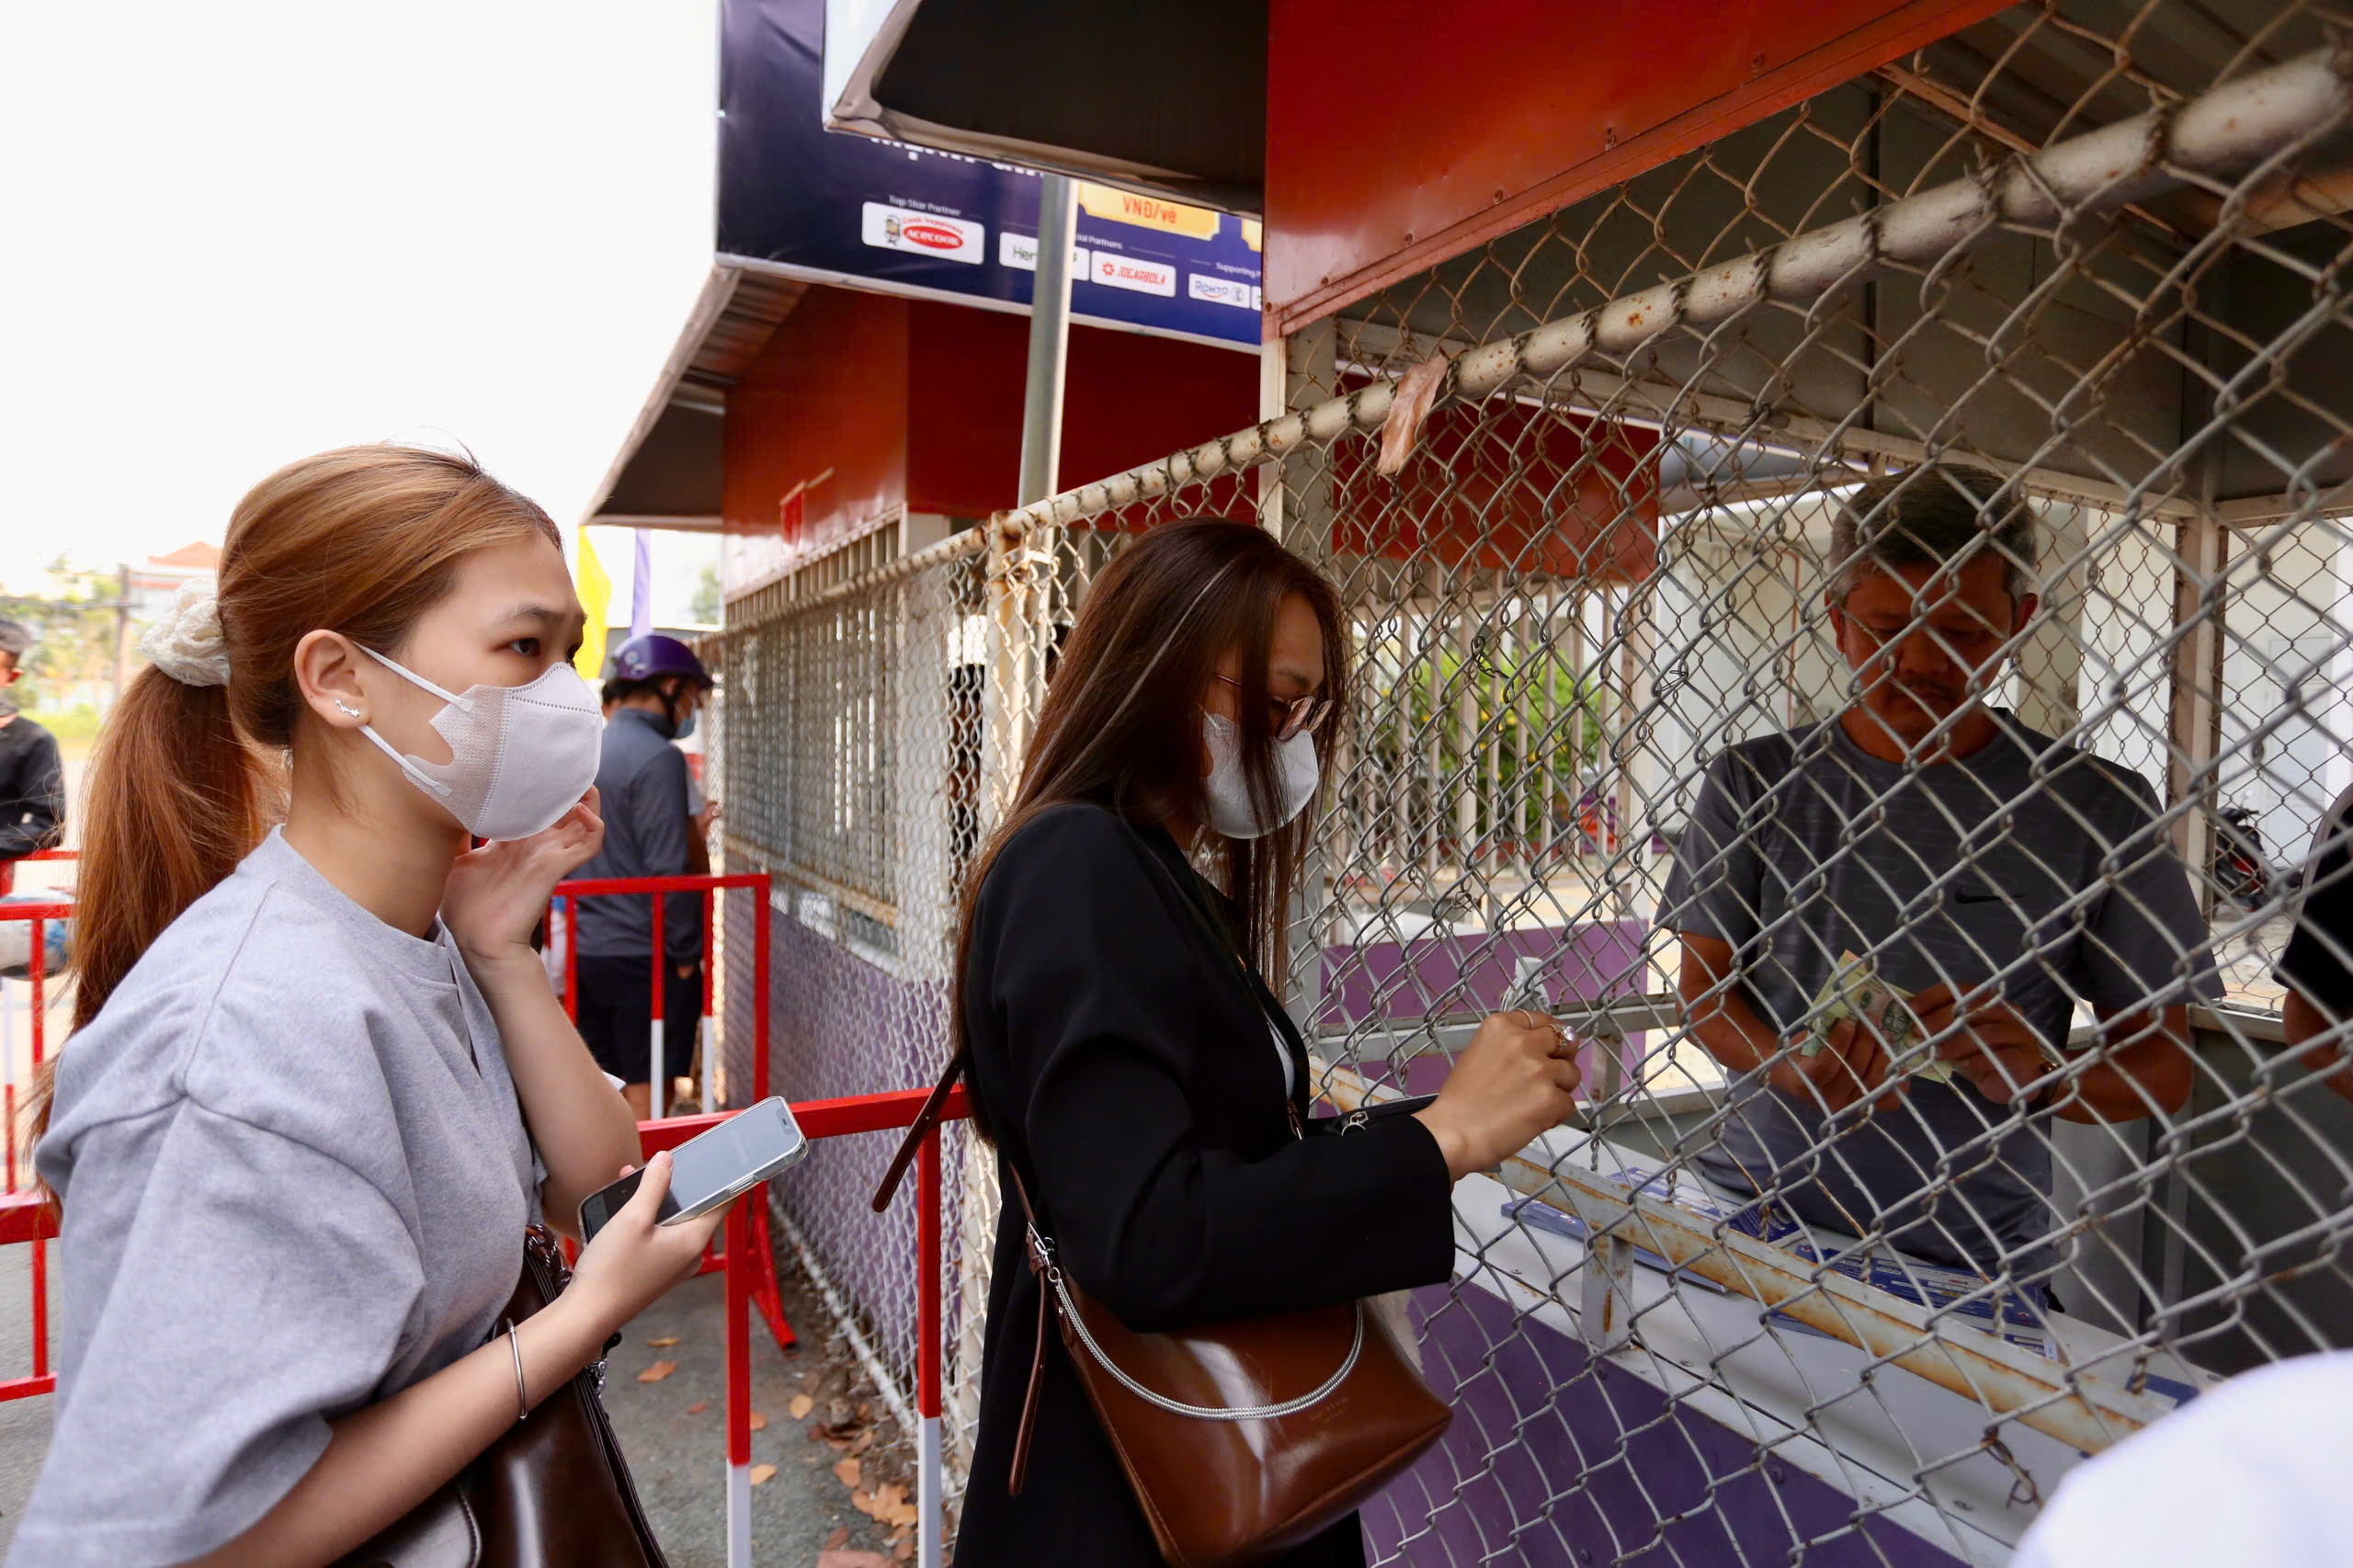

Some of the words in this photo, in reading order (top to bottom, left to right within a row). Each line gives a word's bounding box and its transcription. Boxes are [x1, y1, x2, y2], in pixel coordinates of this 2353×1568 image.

[889, 194, 906, 207] Top
[907, 198, 926, 210] Star
[927, 201, 961, 216] Partner
[1088, 233, 1123, 250] Partners
[1215, 261, 1256, 278] Supporting
